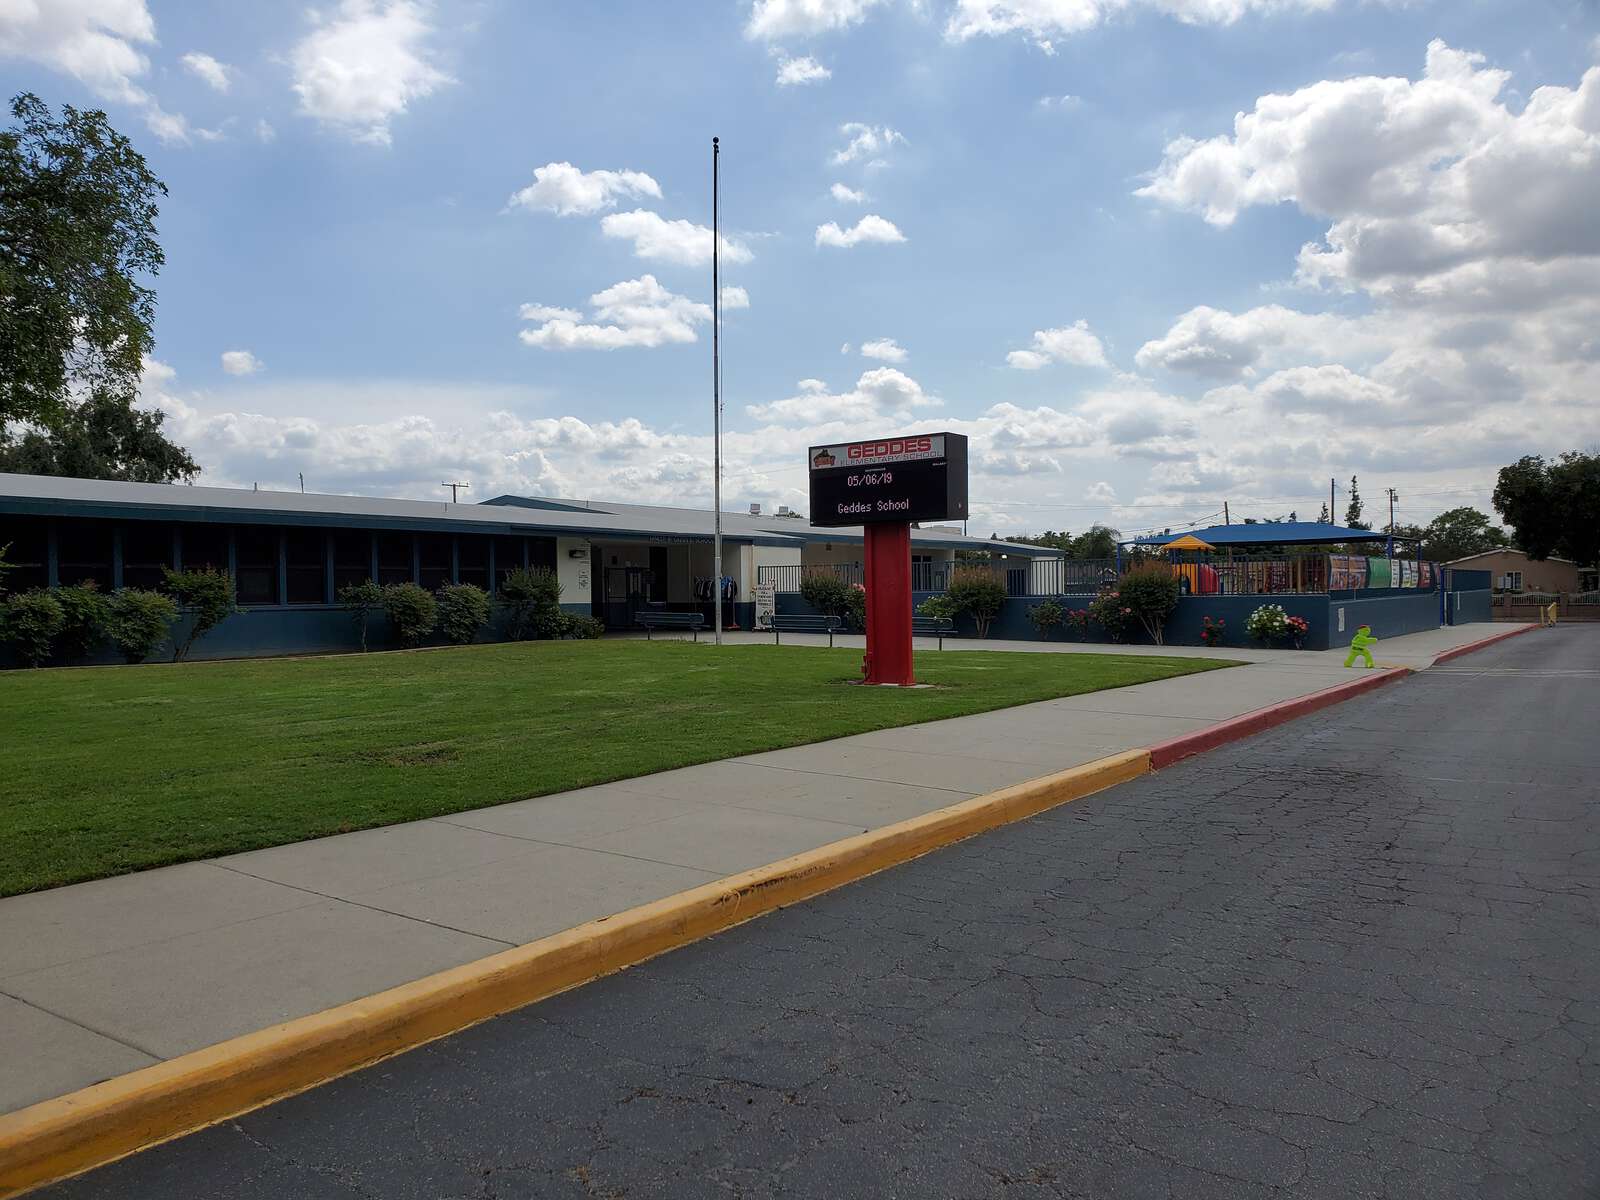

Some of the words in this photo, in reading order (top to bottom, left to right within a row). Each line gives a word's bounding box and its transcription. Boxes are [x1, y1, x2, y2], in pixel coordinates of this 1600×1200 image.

[847, 438, 931, 459] GEDDES
[840, 454, 901, 466] ELEMENTARY
[903, 451, 943, 460] SCHOOL
[847, 472, 893, 487] 05/06/19
[838, 502, 872, 514] Geddes
[876, 498, 910, 512] School
